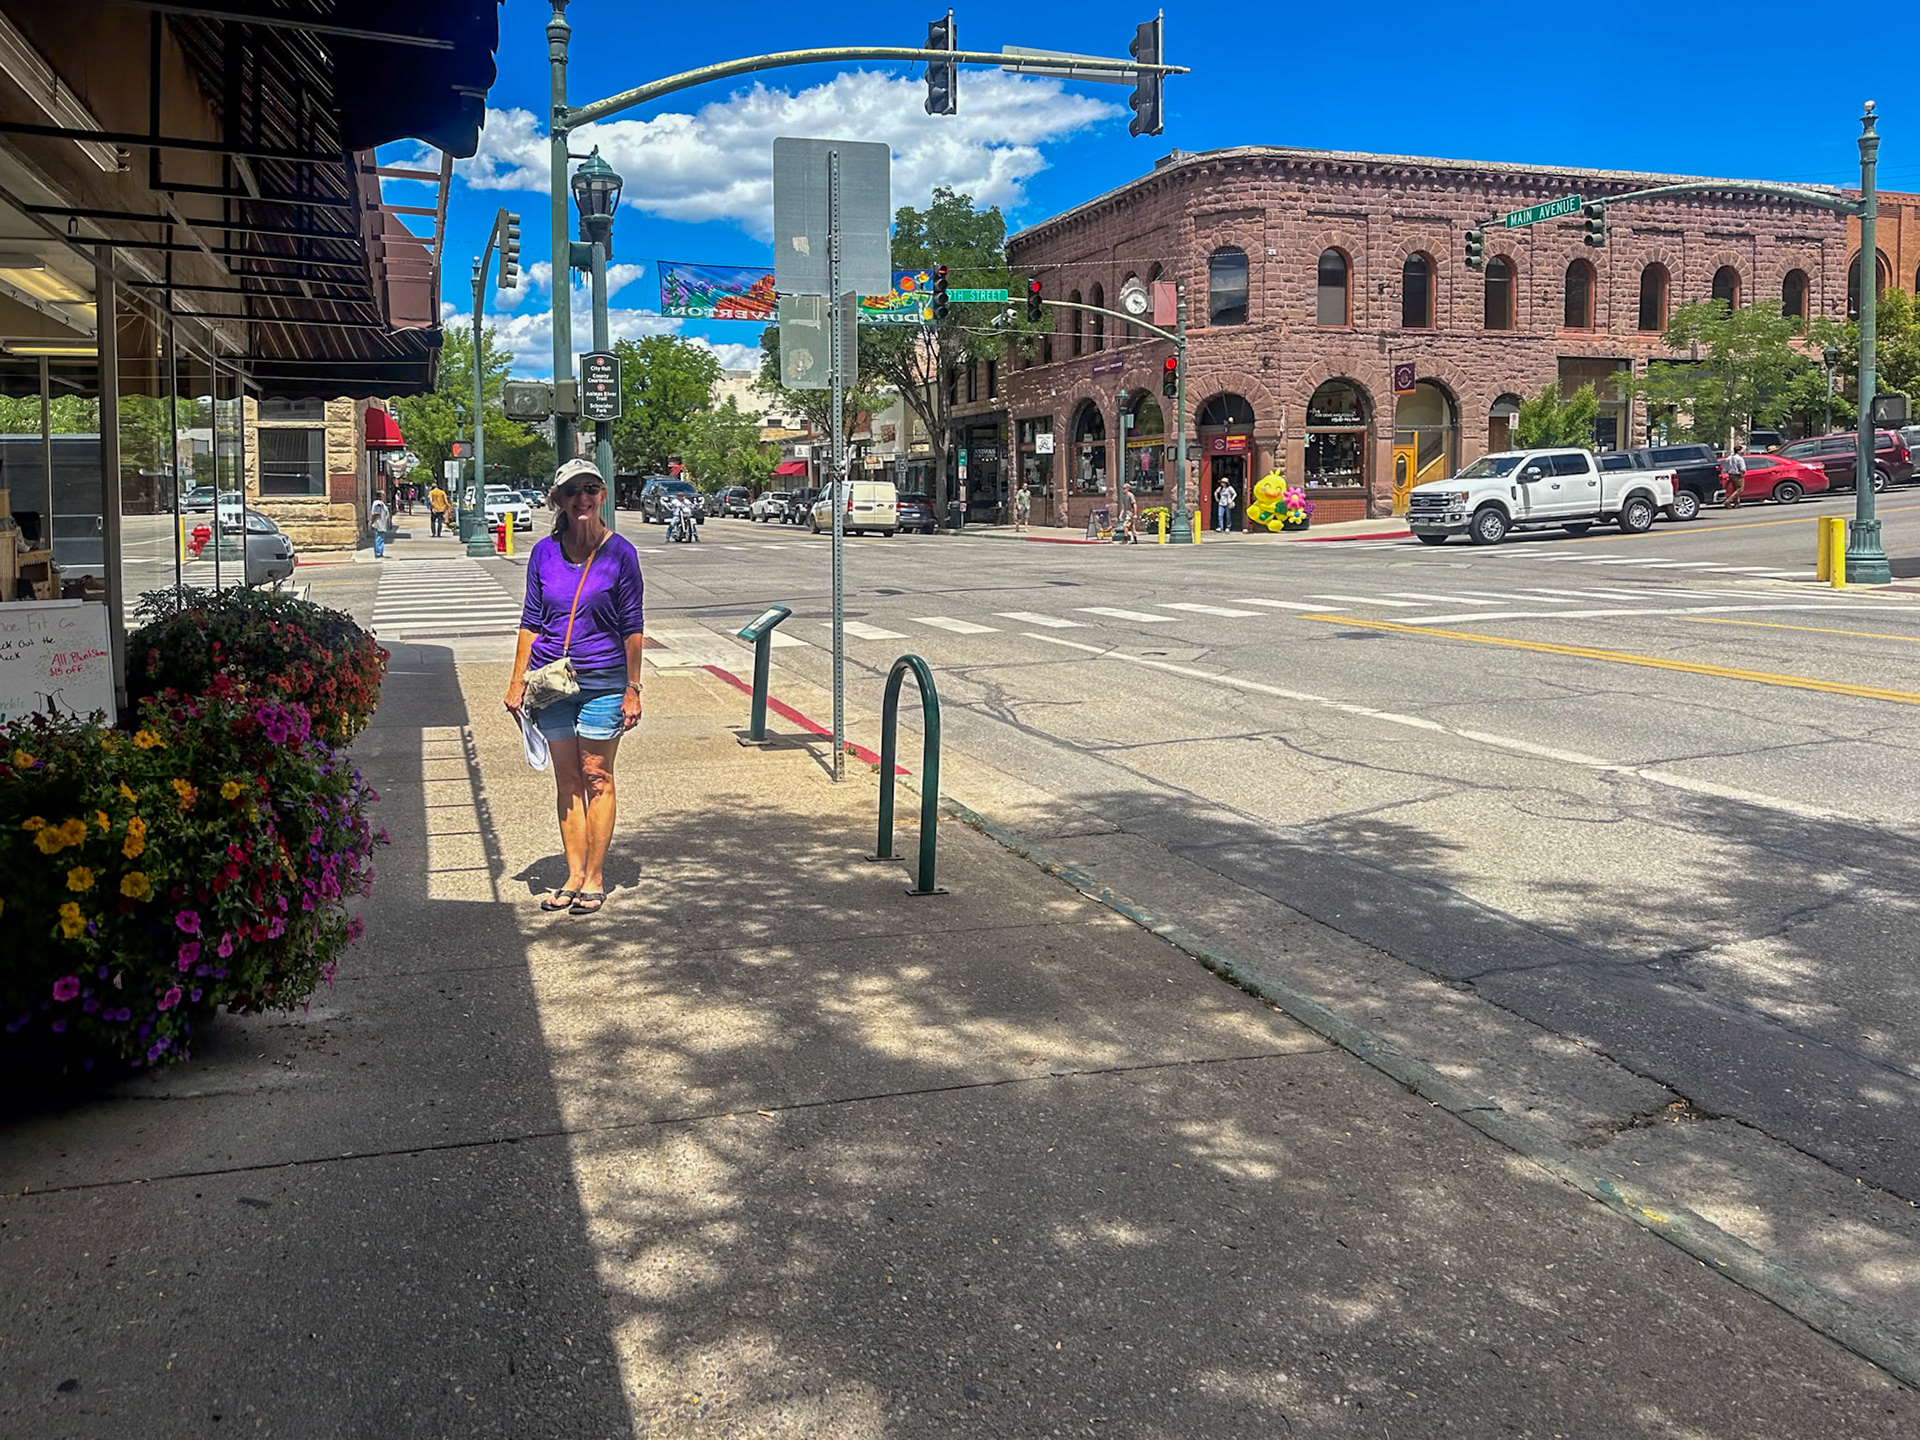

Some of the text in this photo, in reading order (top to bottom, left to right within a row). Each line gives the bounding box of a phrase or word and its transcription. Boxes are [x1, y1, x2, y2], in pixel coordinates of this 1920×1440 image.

[1510, 198, 1576, 226] MAIN AVENUE
[947, 290, 1001, 301] 9TH STREET
[26, 612, 49, 633] Fit
[51, 652, 67, 667] All
